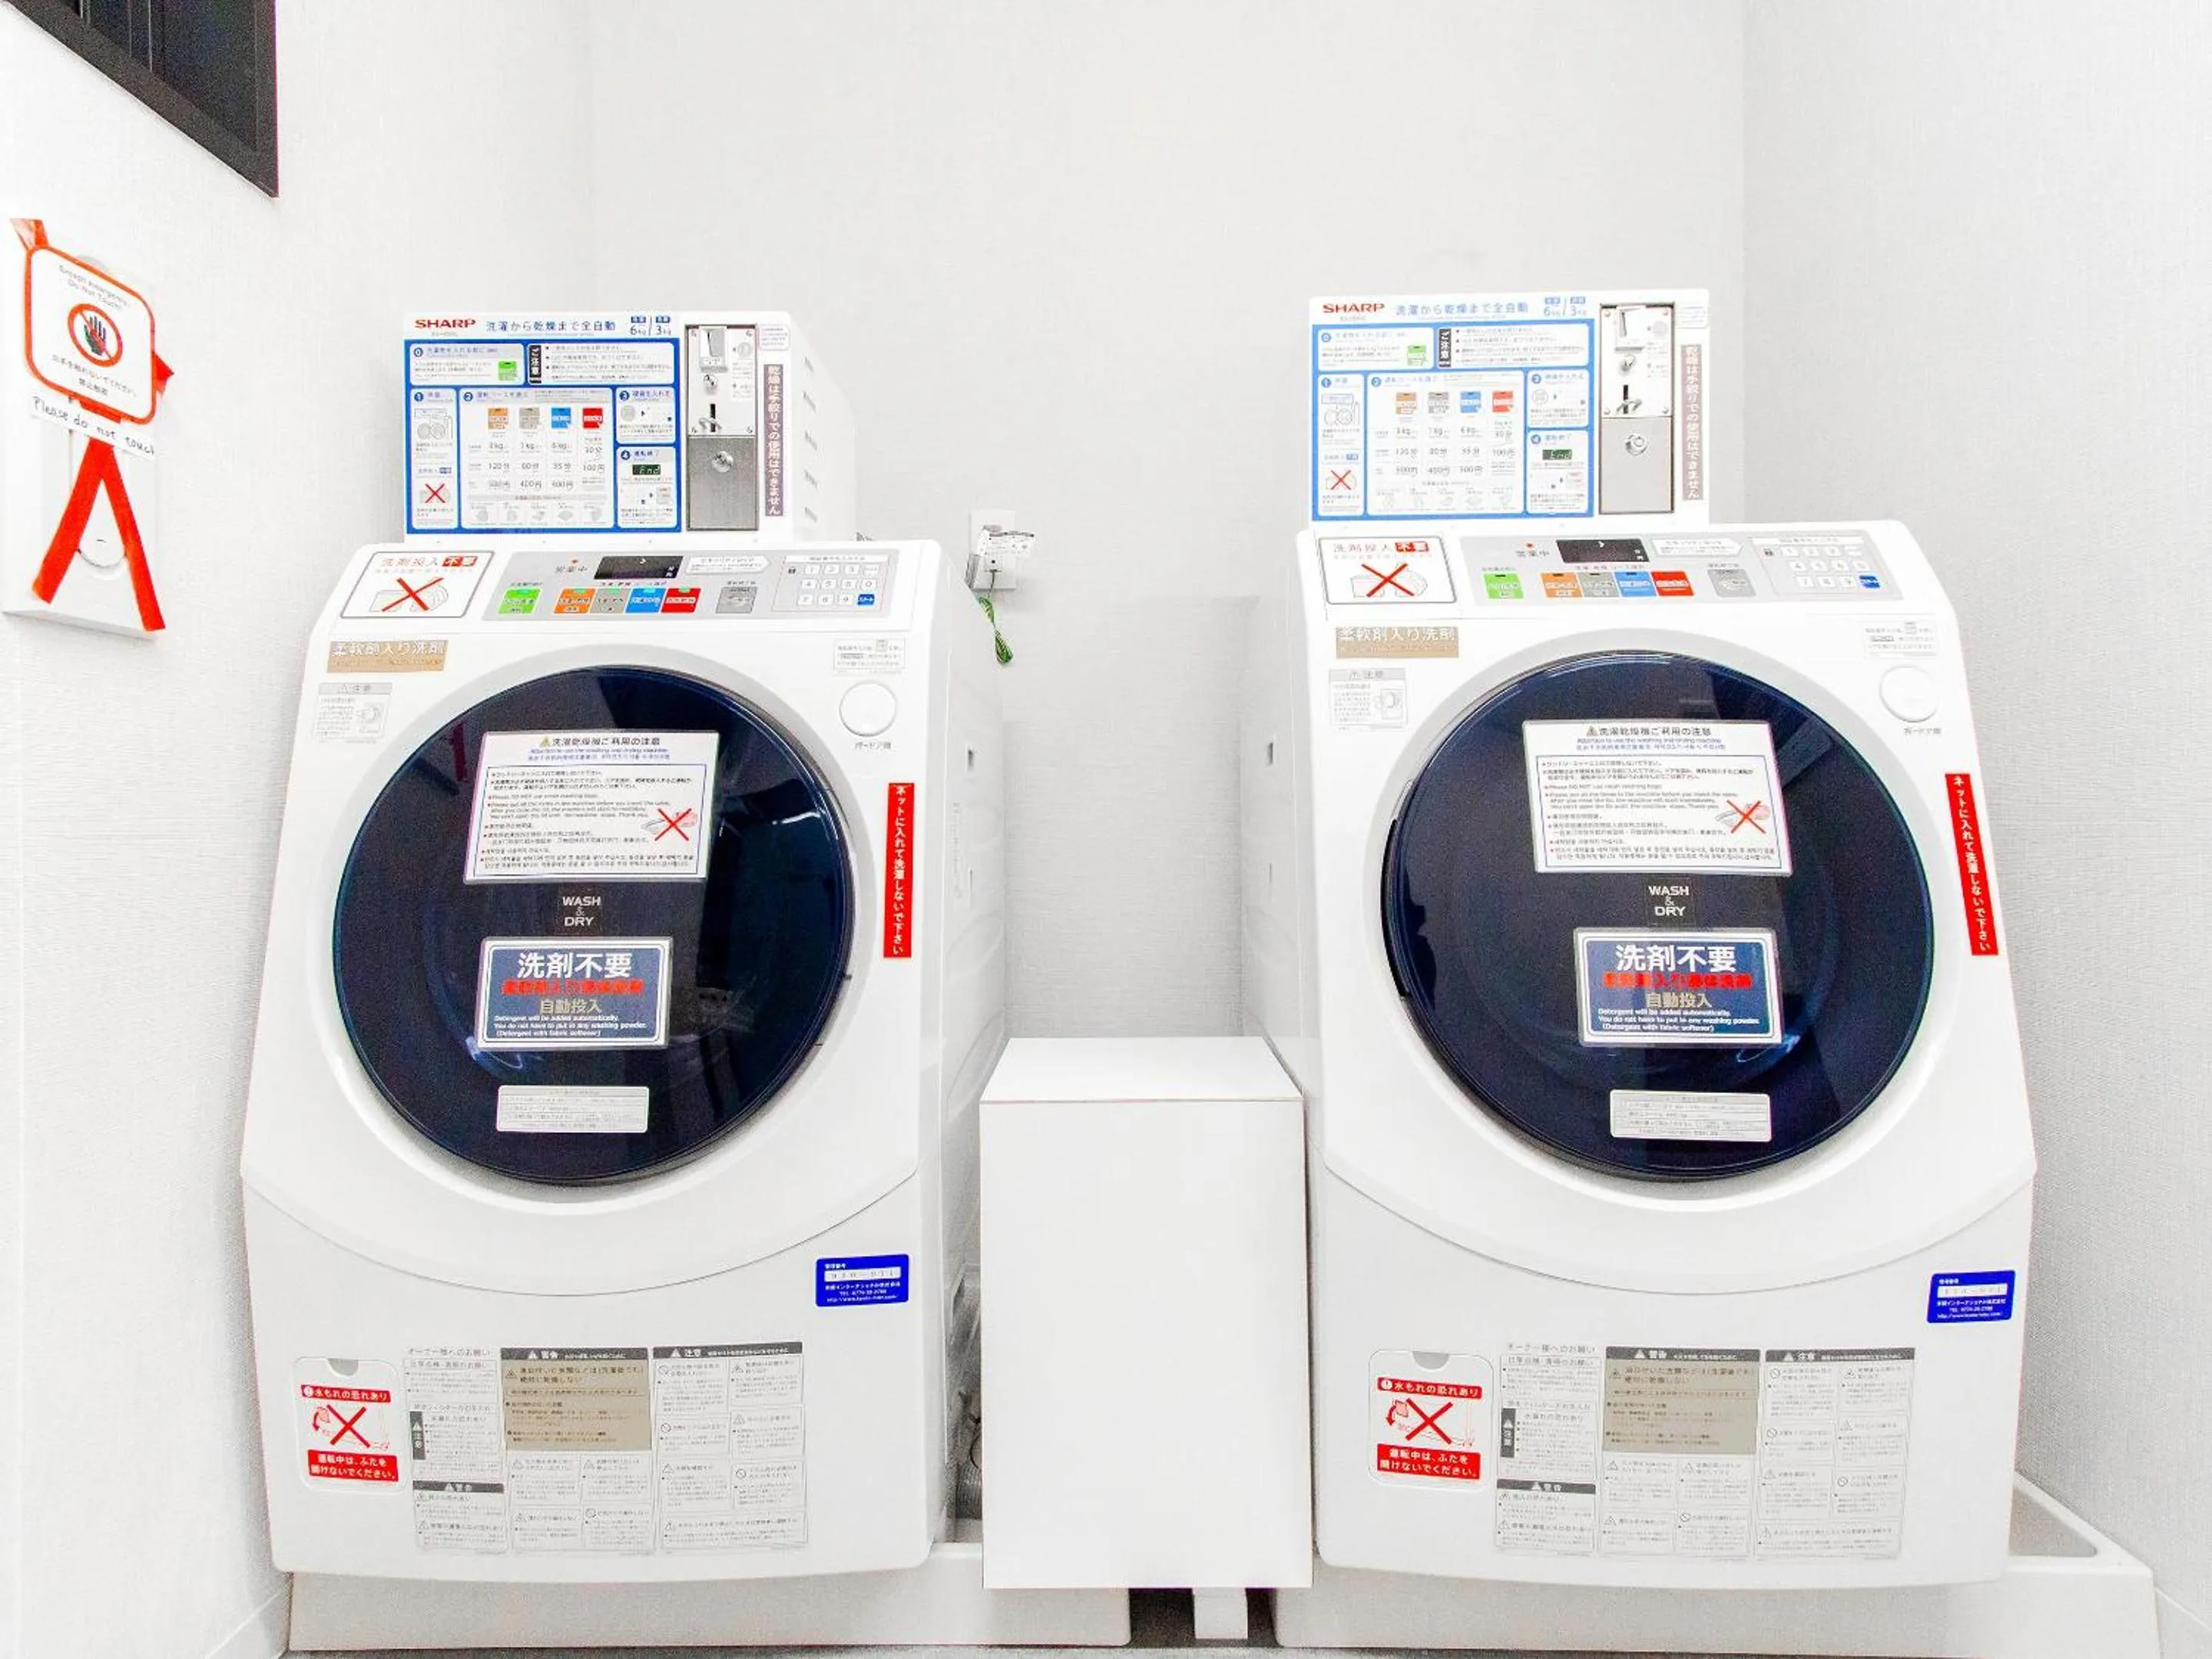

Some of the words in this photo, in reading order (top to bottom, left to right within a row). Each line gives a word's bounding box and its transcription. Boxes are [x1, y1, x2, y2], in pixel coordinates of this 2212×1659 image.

[1323, 303, 1385, 313] SHARP
[1396, 302, 1529, 316] 洗濯から乾燥まで全自動
[415, 319, 477, 329] SHARP
[486, 320, 616, 333] 洗濯から乾燥まで全自動
[32, 395, 69, 422] Please
[73, 412, 89, 430] do
[96, 424, 116, 441] not
[1339, 628, 1455, 641] 柔軟剤入り洗剤
[333, 641, 445, 656] 柔軟剤入り洗剤
[1599, 726, 1712, 737] 洗濯乾燥機ご利用の注意
[551, 737, 660, 747] 洗濯乾燥機ご利用の注意
[892, 786, 906, 955] ネットに入れて洗濯しないで下さい
[1953, 777, 1991, 951] ネットに入れて洗濯しないで下さい
[1648, 886, 1689, 896] WASH
[563, 896, 601, 906] WASH
[1664, 896, 1674, 906] &
[576, 907, 584, 916] &
[1654, 906, 1686, 916] DRY
[565, 917, 594, 927] DRY
[1616, 945, 1737, 972] 洗剤不要
[517, 952, 633, 979] 洗剤不要
[541, 999, 601, 1014] 自動投入
[1647, 992, 1712, 1008] 自動投入
[315, 1389, 387, 1401] 水もれの恐れあり
[1394, 1382, 1479, 1397] 水もれの恐れあり
[318, 1454, 387, 1467] 運転中は、ふたを
[1389, 1449, 1469, 1465] 運転中は、ふたを
[311, 1465, 396, 1479] 開けないでください。
[1380, 1459, 1476, 1477] 開けないでください。
